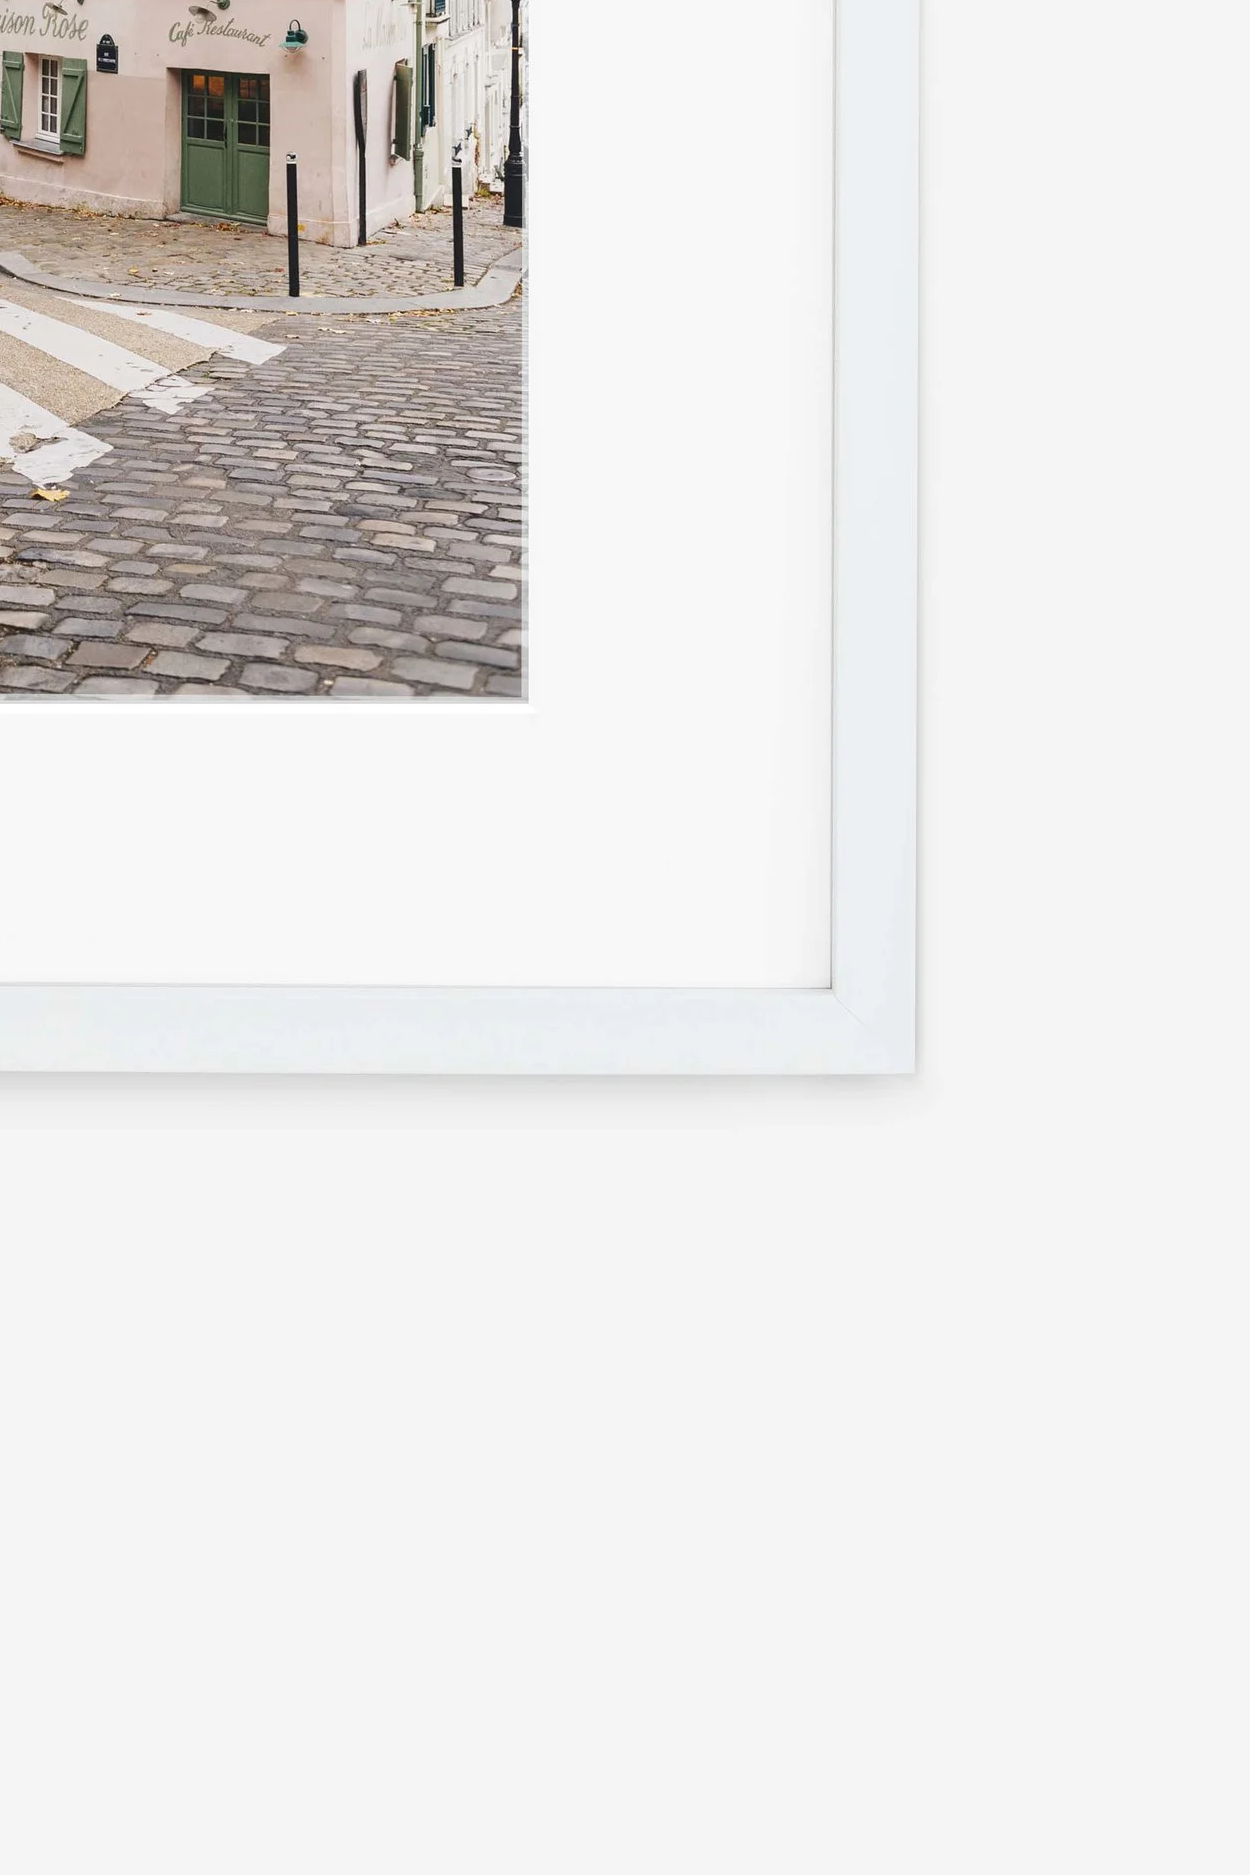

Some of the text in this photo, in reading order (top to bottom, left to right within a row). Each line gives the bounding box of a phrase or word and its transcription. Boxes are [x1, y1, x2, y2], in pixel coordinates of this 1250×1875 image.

[39, 2, 89, 41] Rose
[168, 17, 271, 47] Café Restaurant
